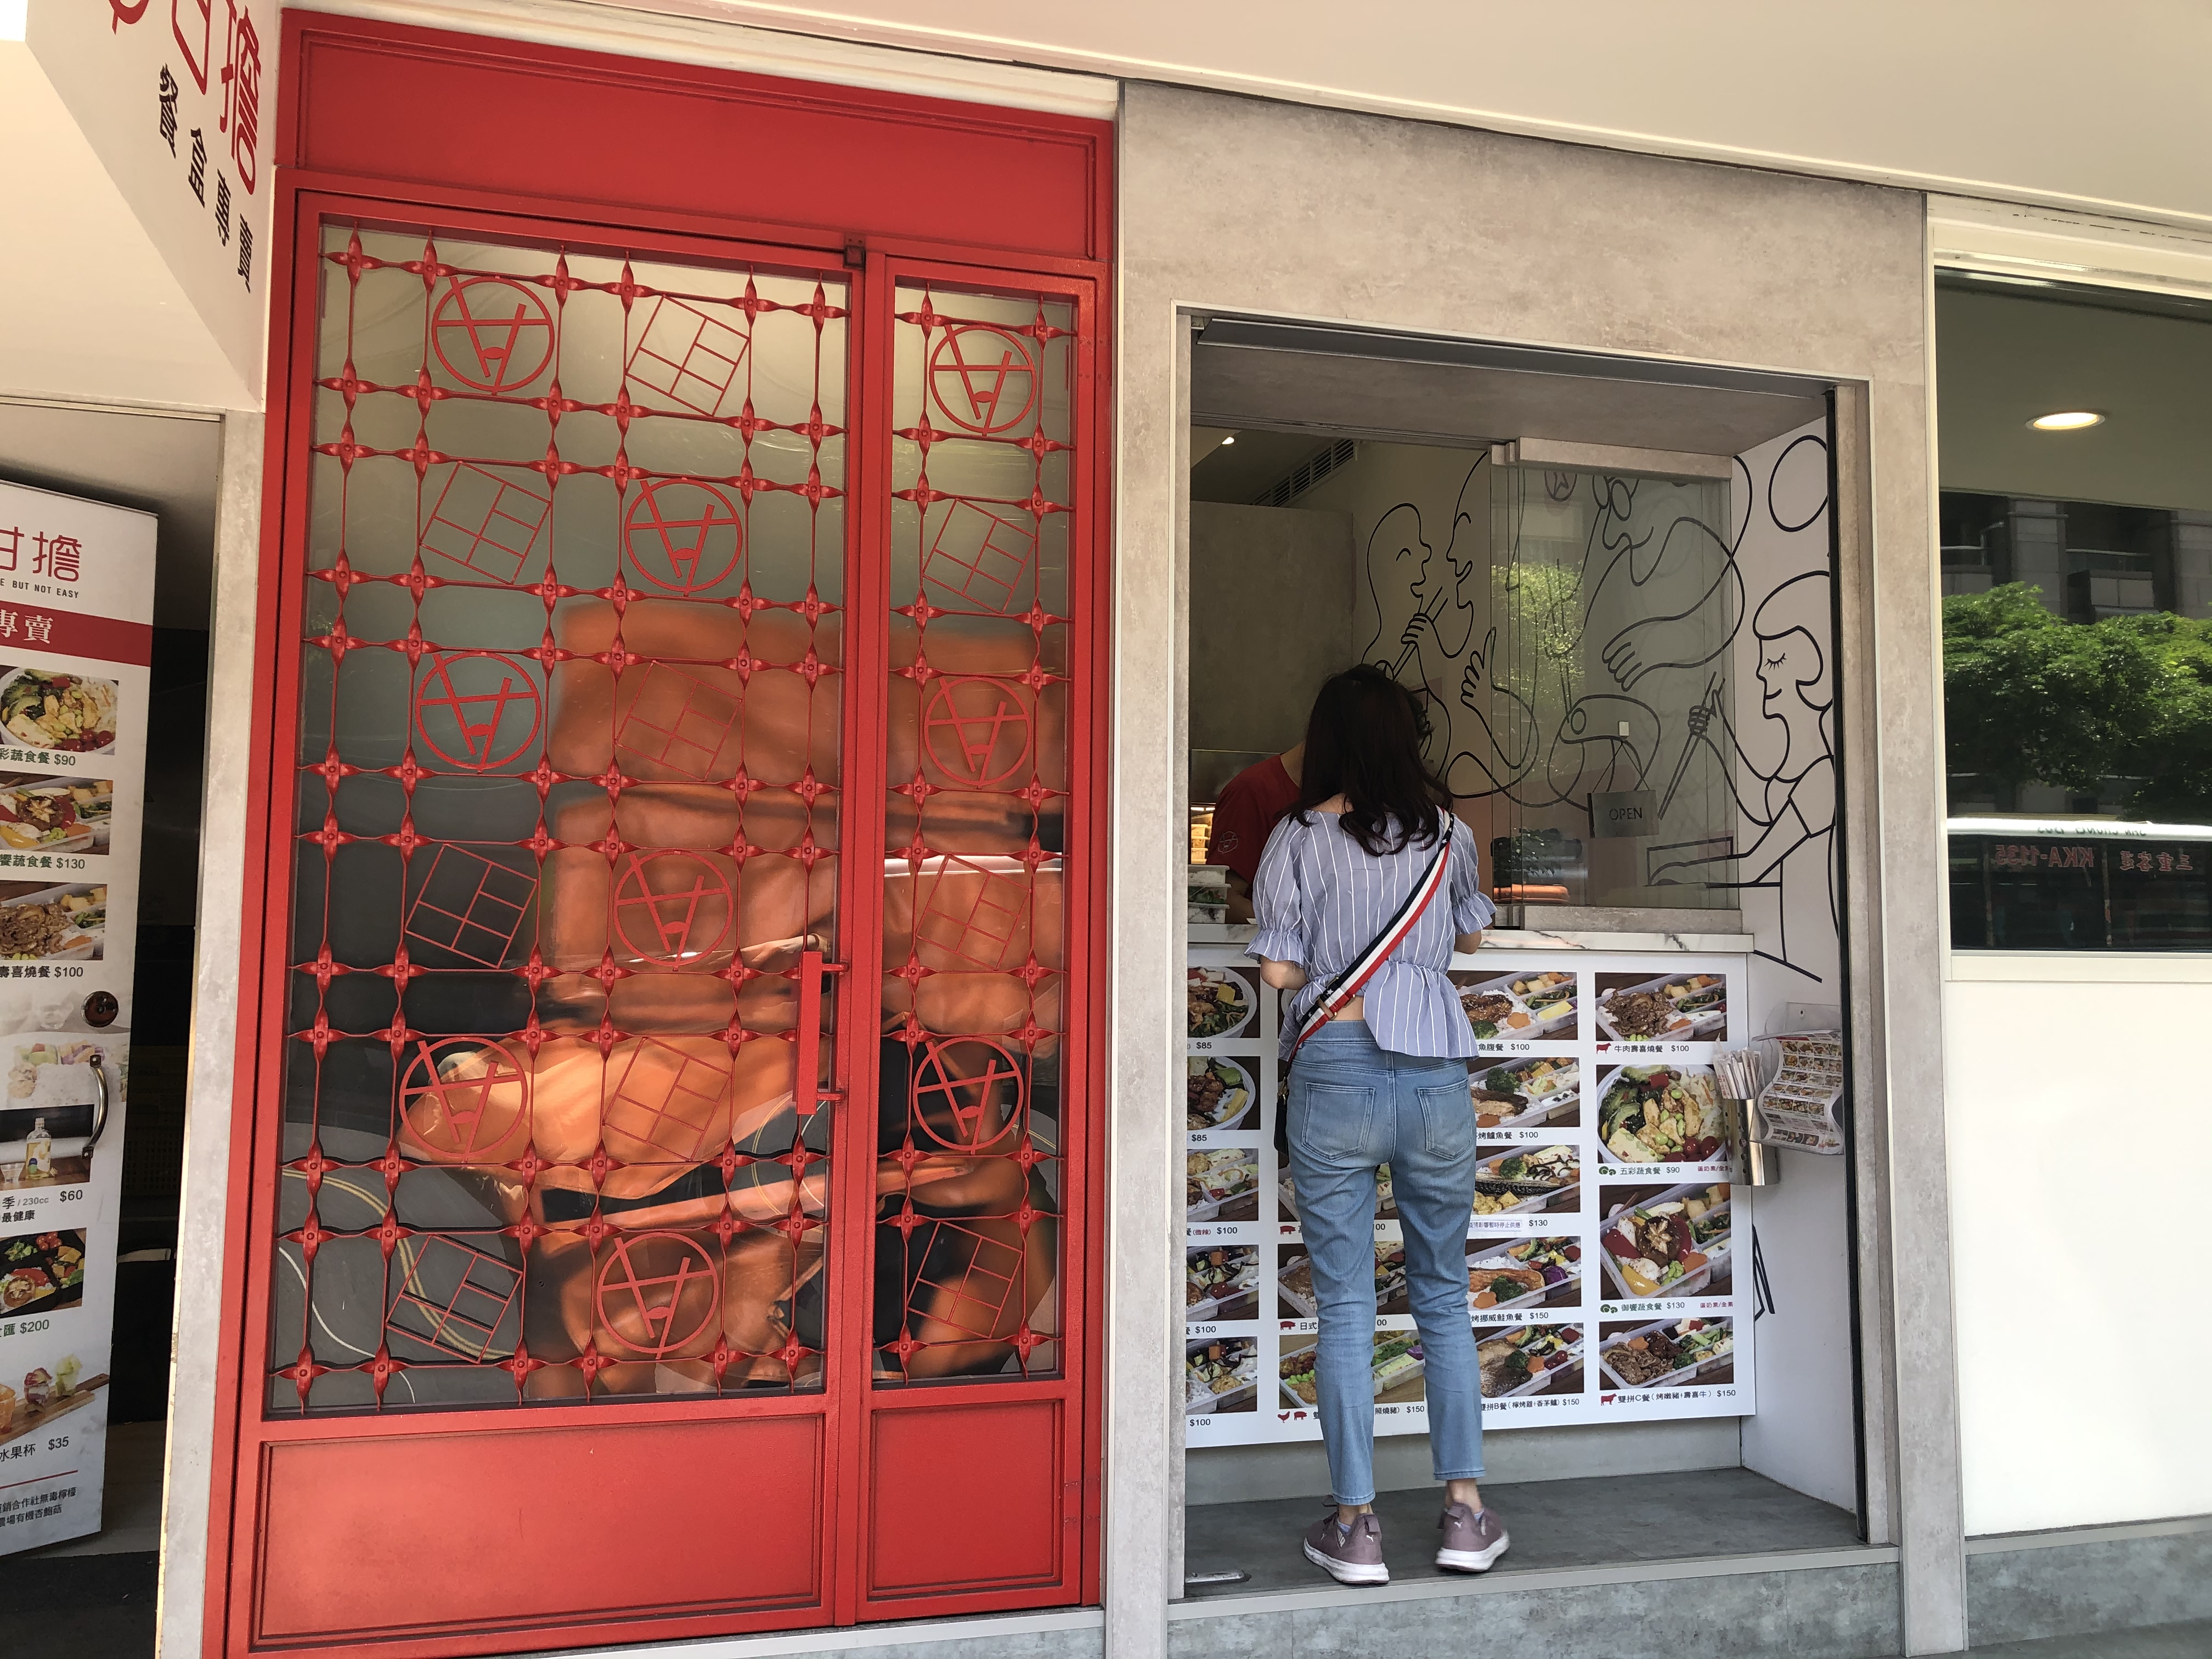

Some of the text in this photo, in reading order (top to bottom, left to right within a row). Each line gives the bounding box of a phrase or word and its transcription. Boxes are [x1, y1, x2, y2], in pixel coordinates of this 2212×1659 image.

[159, 63, 253, 294] 餐盒專賣
[12, 580, 29, 590] BUT
[34, 584, 52, 594] NOT
[57, 588, 78, 599] EASY
[54, 754, 76, 766] $90
[1610, 808, 1643, 820] OPEN
[57, 857, 85, 869] $130
[54, 966, 83, 978] $100
[1620, 1167, 1661, 1175] 五彩蔬食餐
[59, 1189, 83, 1203] $60
[2, 1210, 35, 1223] 最健康
[20, 1319, 49, 1334] $200
[48, 1436, 69, 1451] $35
